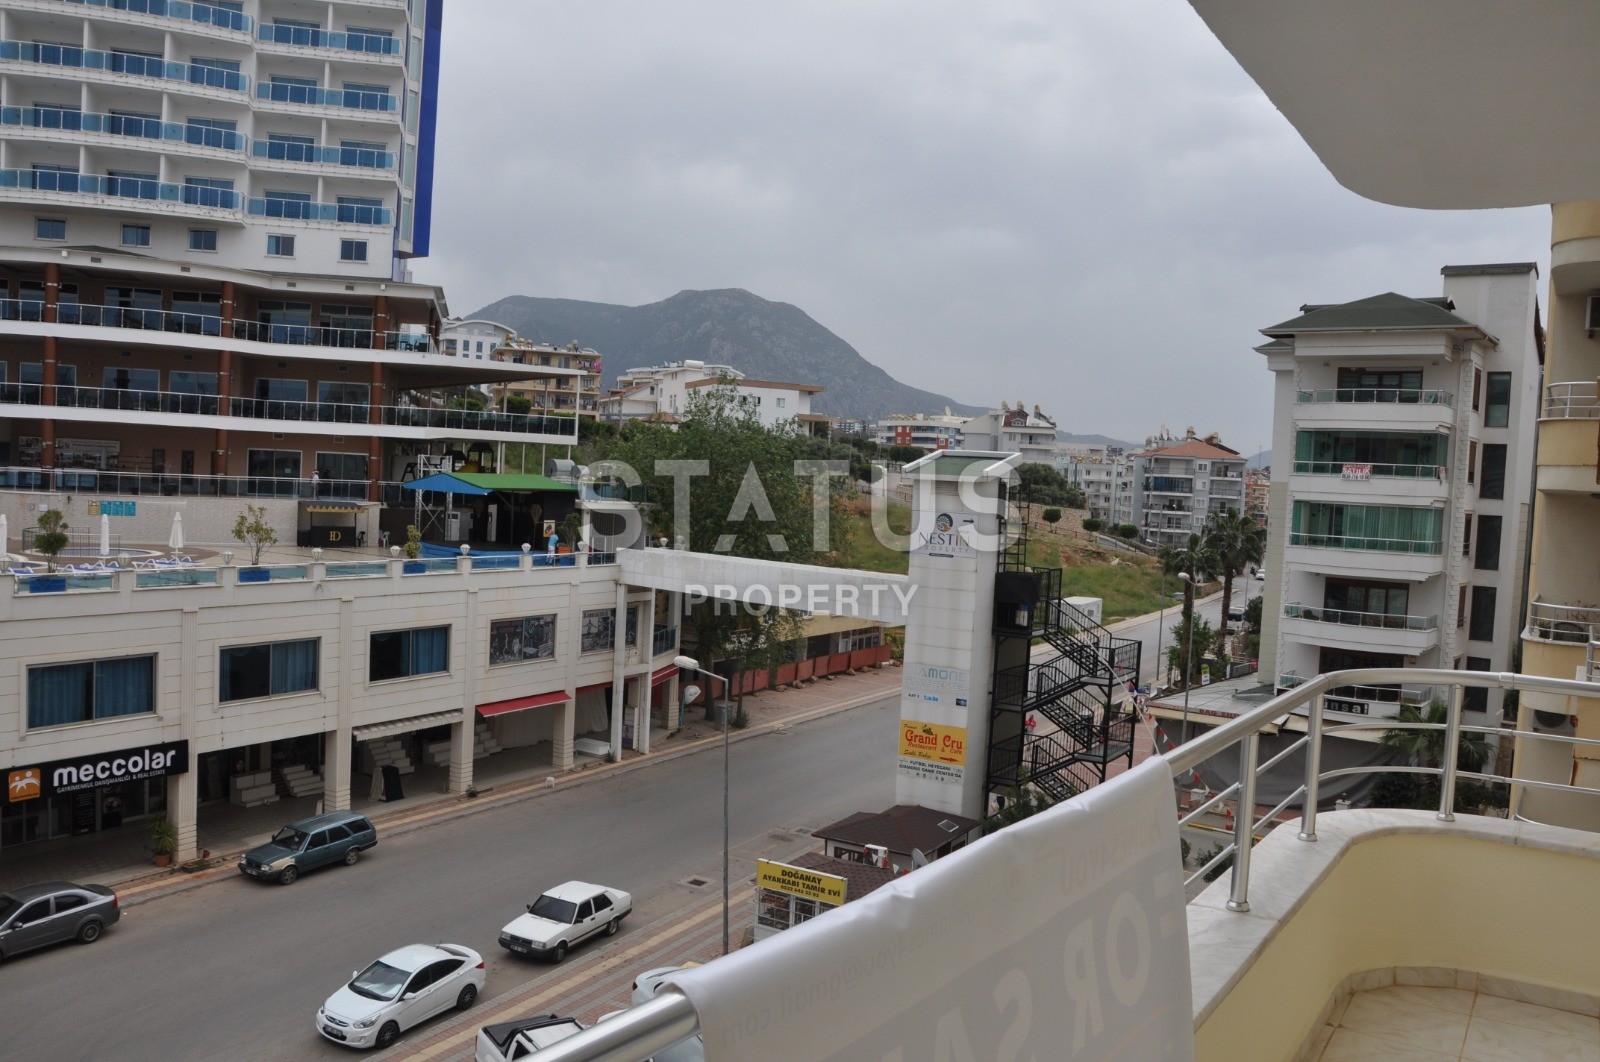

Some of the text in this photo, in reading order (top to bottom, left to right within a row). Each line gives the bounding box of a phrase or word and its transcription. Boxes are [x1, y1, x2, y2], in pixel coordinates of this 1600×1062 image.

[905, 729, 963, 750] Grand Cru
[53, 749, 177, 787] meccolar
[137, 772, 149, 780] REAL
[149, 769, 166, 777] ESTATE
[763, 873, 800, 888] AYAKKABI
[781, 870, 823, 885] DOĞANAY
